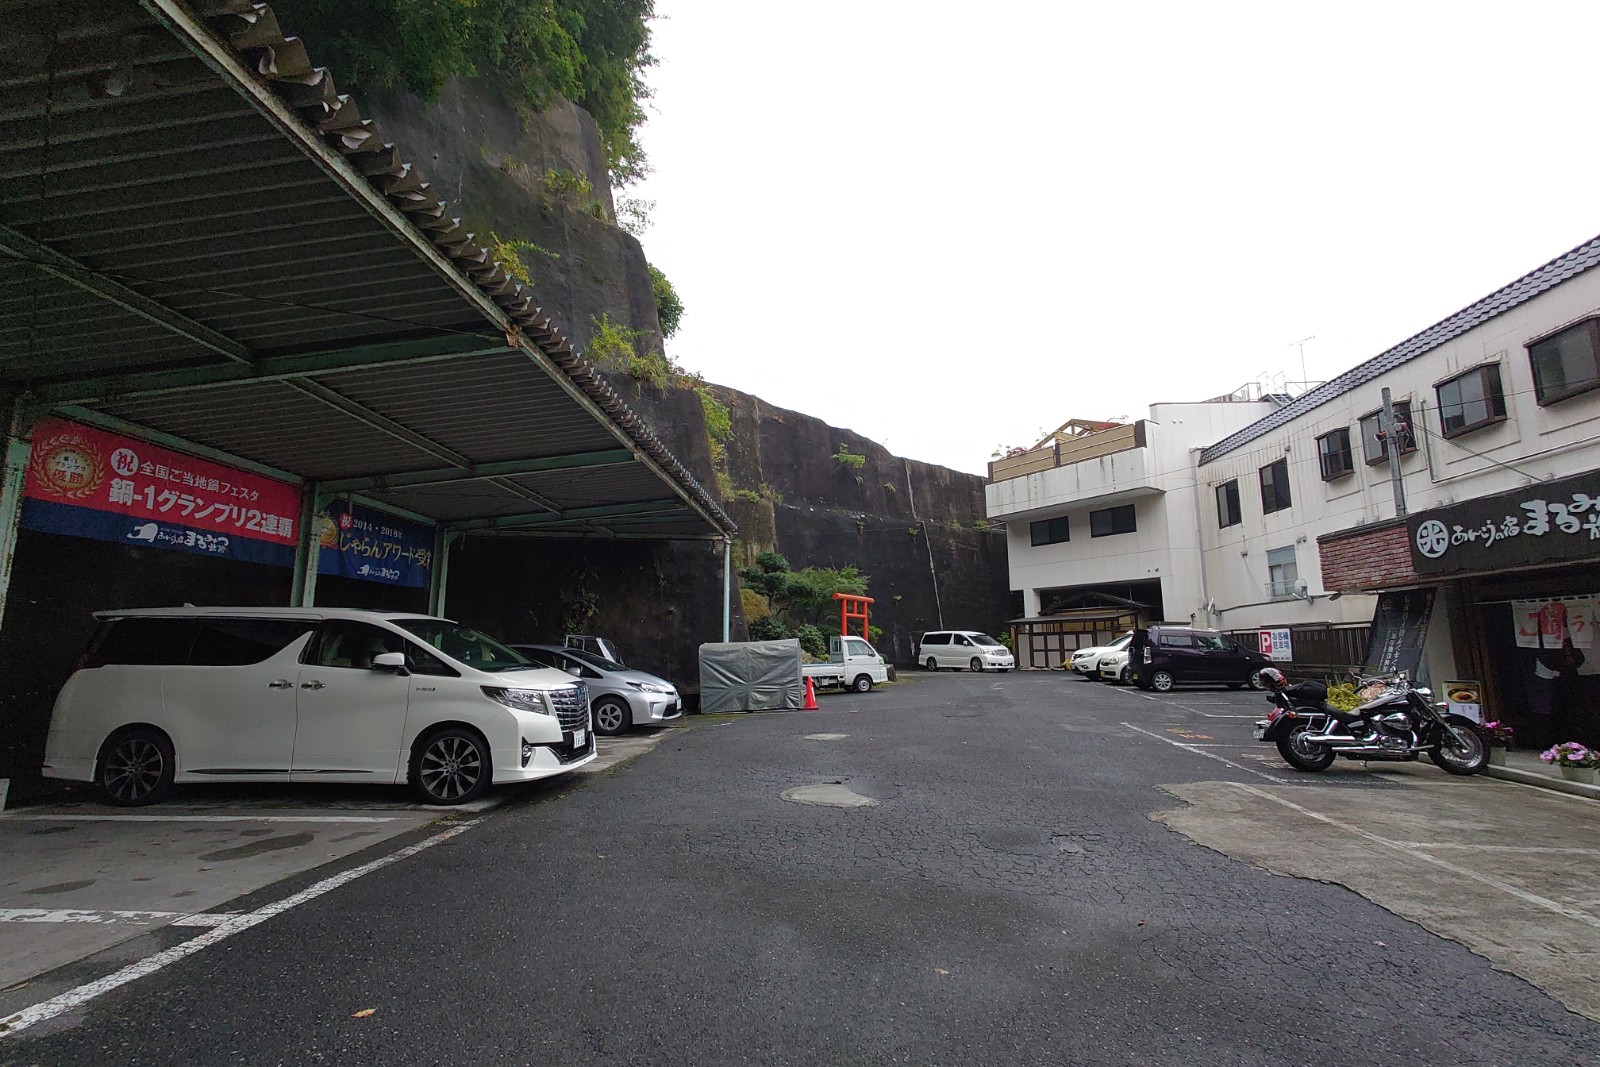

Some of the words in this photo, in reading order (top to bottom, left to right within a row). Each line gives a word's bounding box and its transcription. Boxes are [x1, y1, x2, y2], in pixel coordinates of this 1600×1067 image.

[115, 450, 135, 473] 祝
[140, 461, 260, 501] 全国ご当地鍋フェスタ
[108, 477, 294, 539] 鍋-1グランプリ2連覇
[1261, 633, 1271, 652] P
